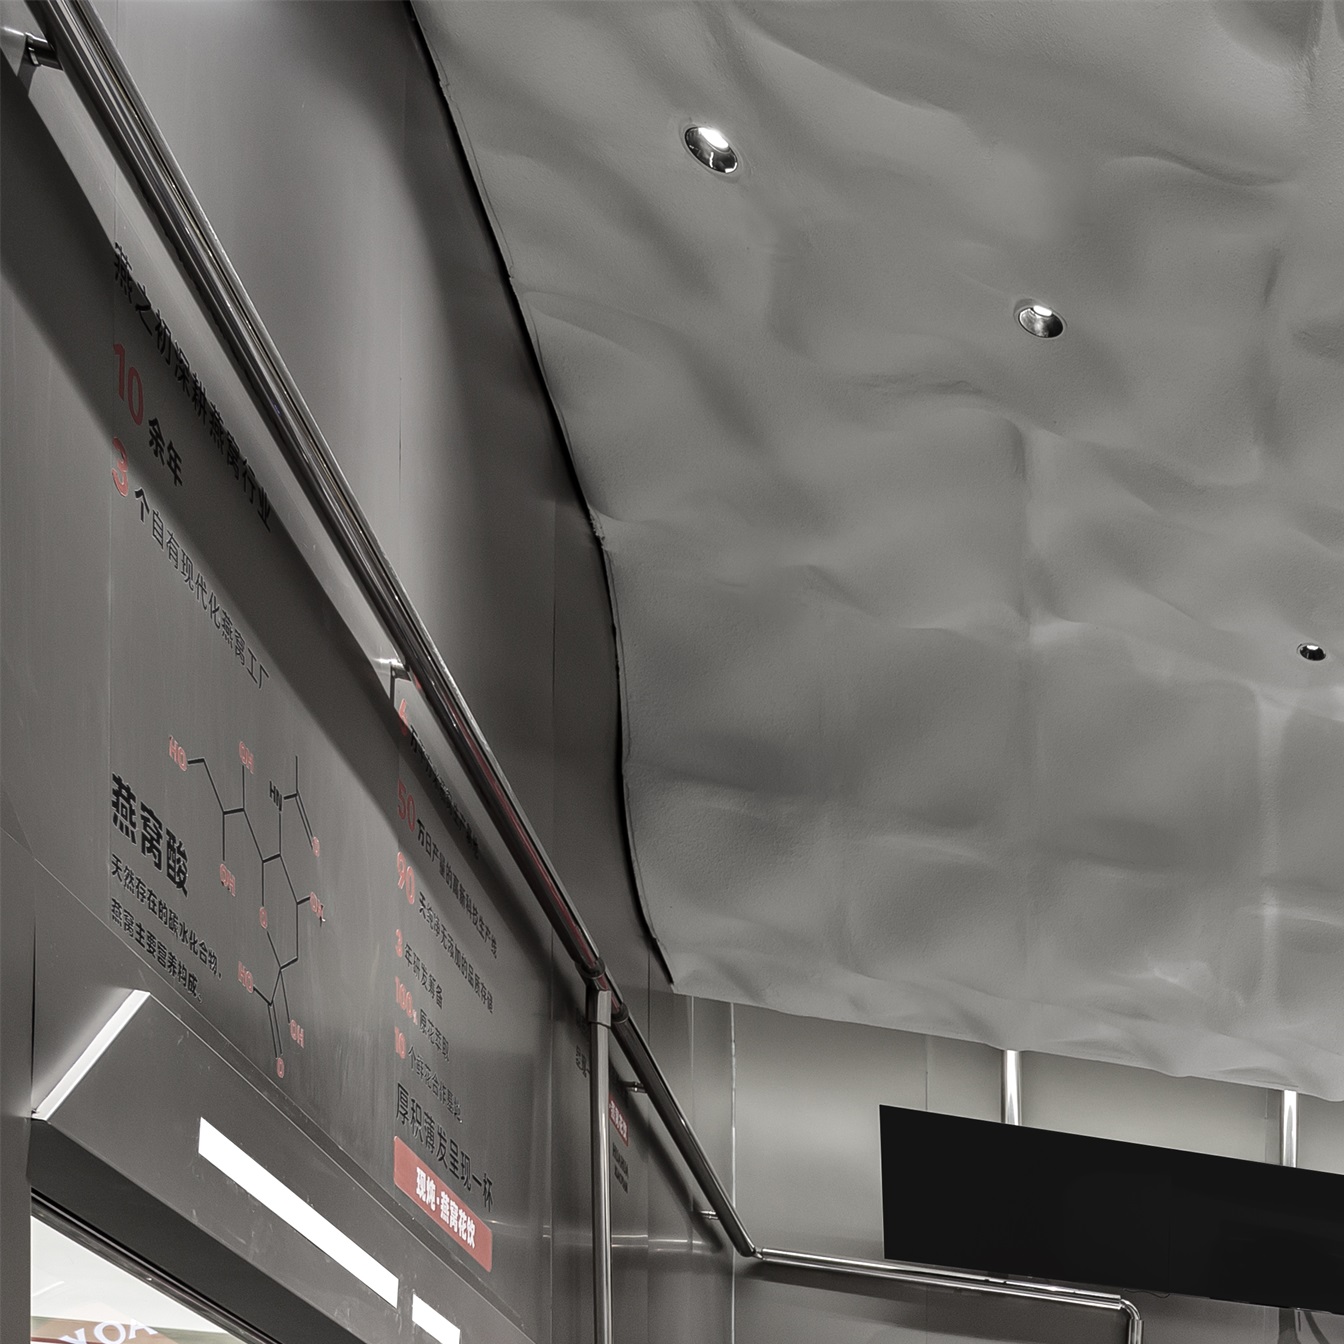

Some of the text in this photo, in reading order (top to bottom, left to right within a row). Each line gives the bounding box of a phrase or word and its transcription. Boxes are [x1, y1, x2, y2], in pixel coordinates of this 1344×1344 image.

[111, 773, 189, 898] 燕窝酸
[396, 1083, 493, 1212] 厚积薄发呈现一杯
